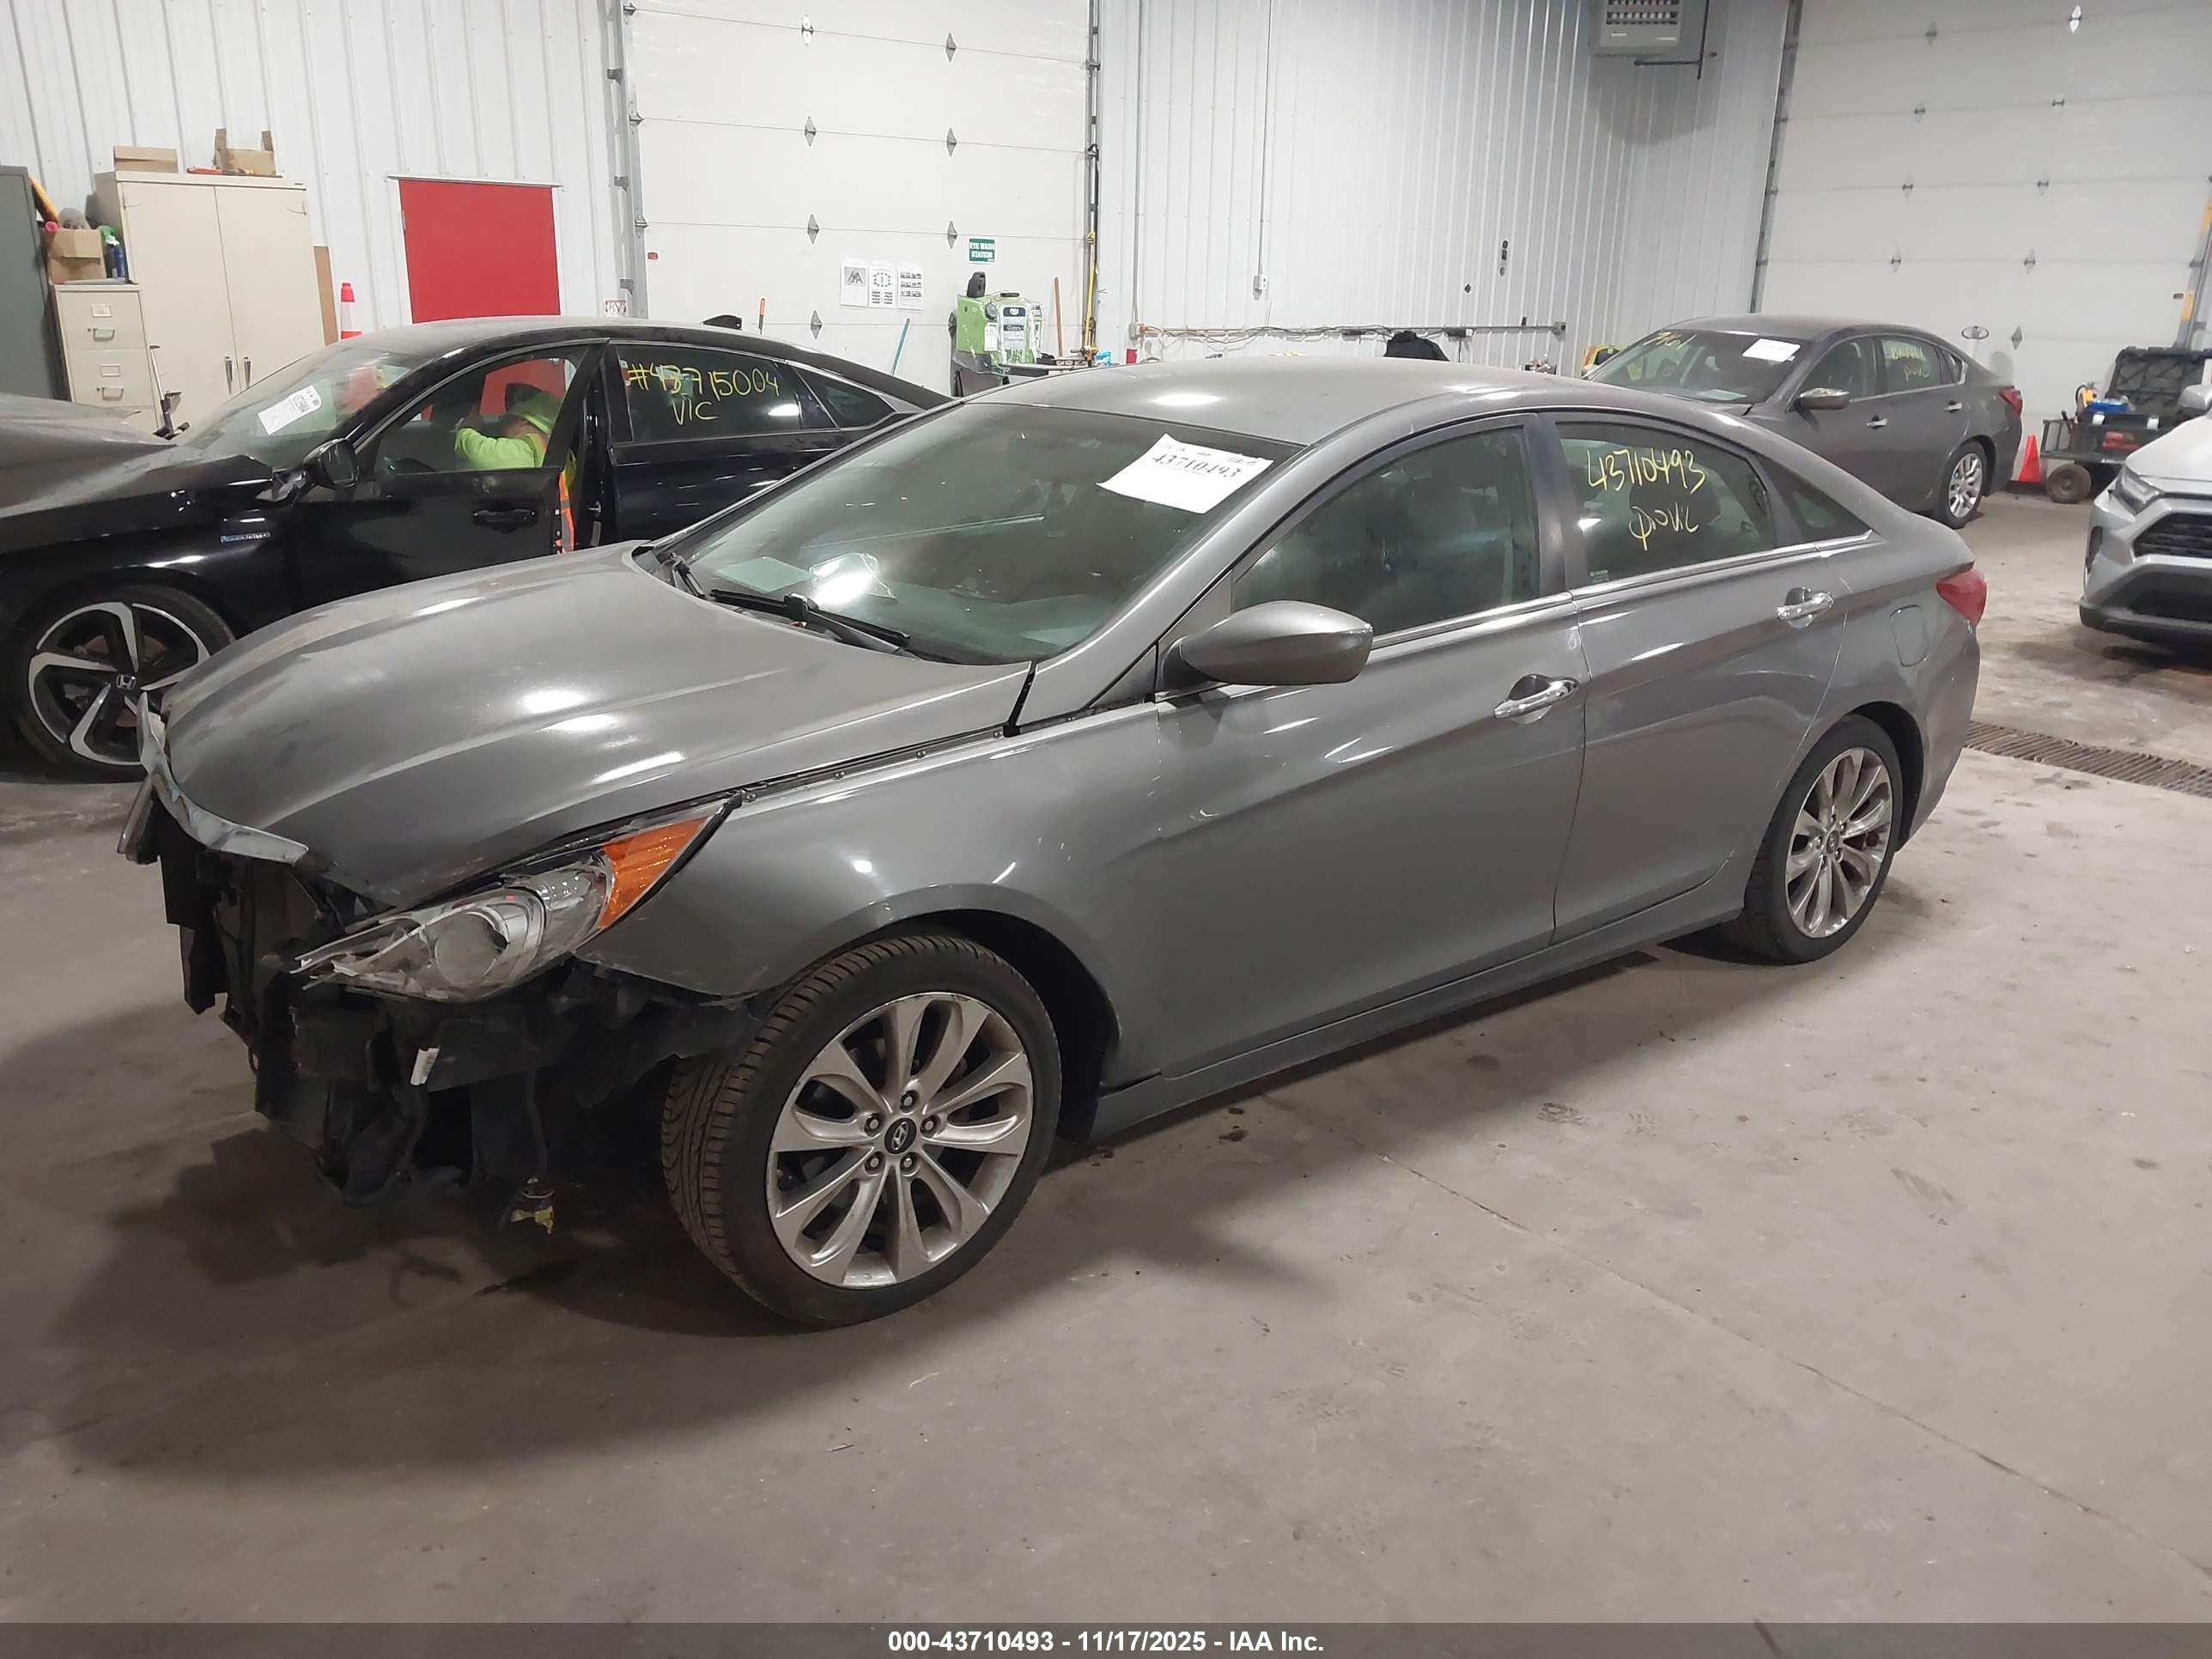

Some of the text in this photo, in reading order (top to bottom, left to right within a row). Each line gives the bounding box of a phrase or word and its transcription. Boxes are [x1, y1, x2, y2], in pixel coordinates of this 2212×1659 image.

[980, 242, 996, 251] WASH
[672, 398, 720, 426] VIC
[1152, 453, 1242, 478] 43710493
[1587, 447, 1705, 495] 43710493
